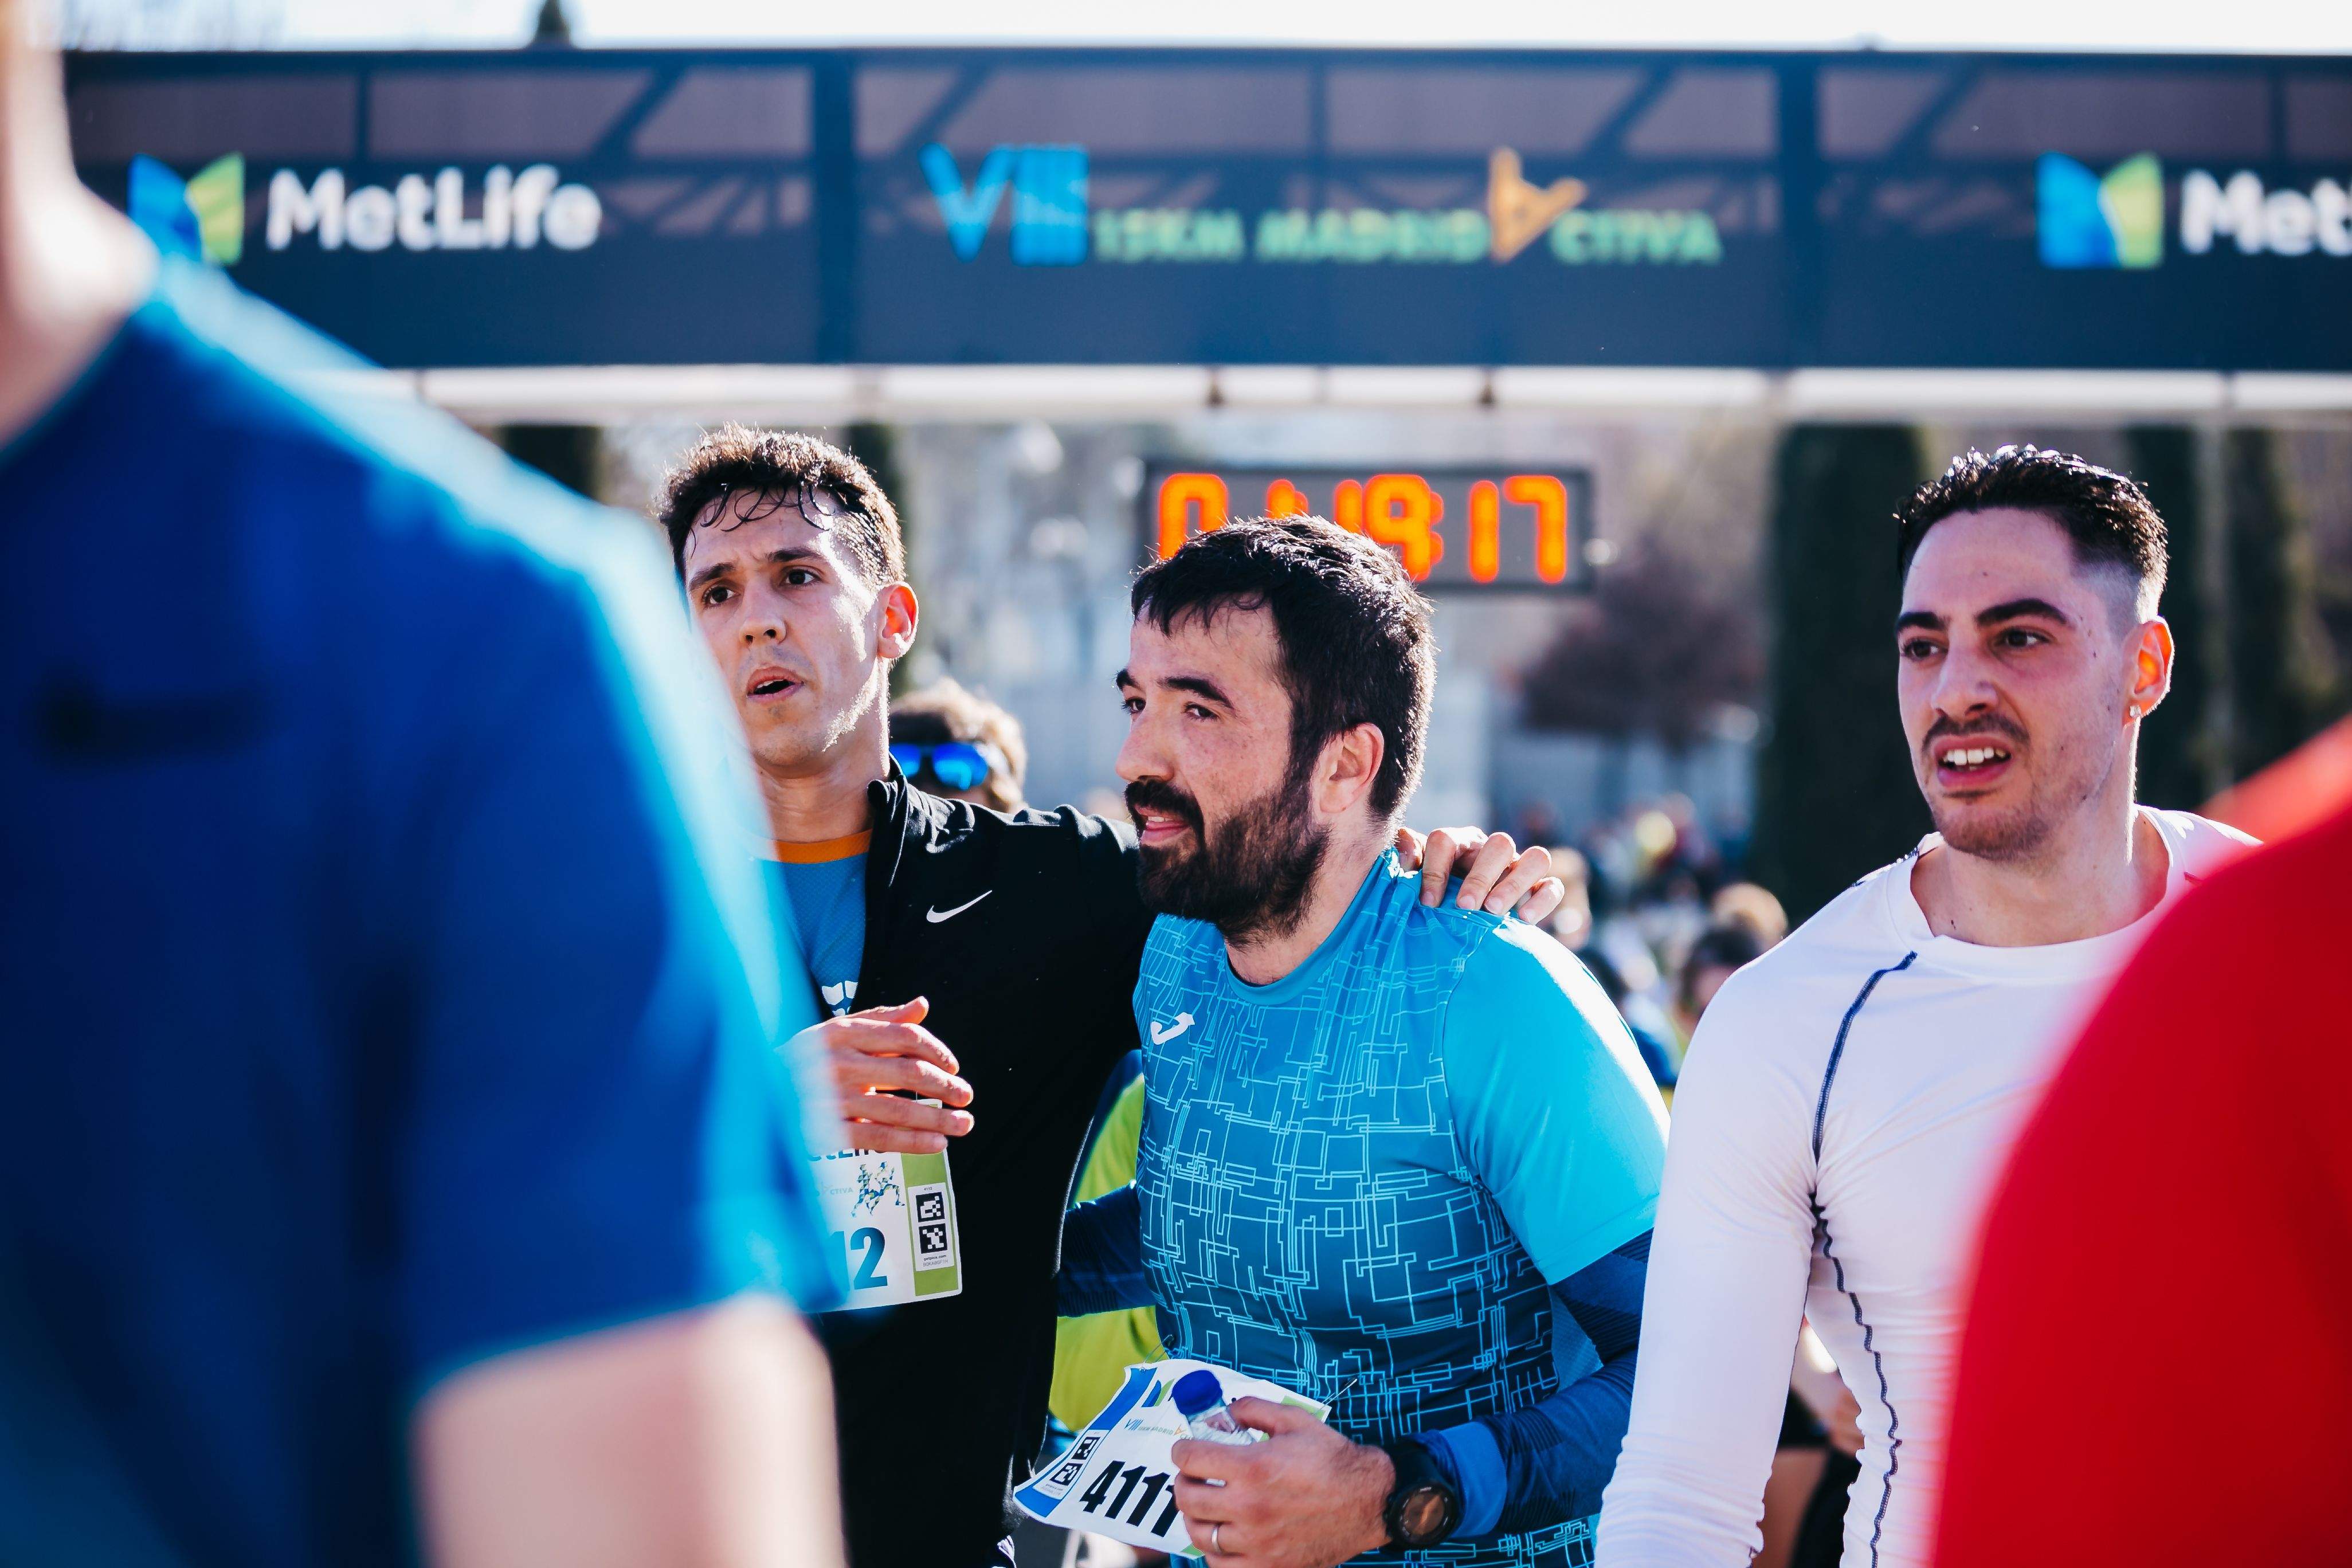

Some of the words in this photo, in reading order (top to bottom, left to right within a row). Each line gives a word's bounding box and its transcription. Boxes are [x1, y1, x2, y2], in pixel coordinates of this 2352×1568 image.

[266, 165, 602, 250] MetLife
[1258, 209, 1490, 264] MADRID
[2180, 170, 2352, 256] Met
